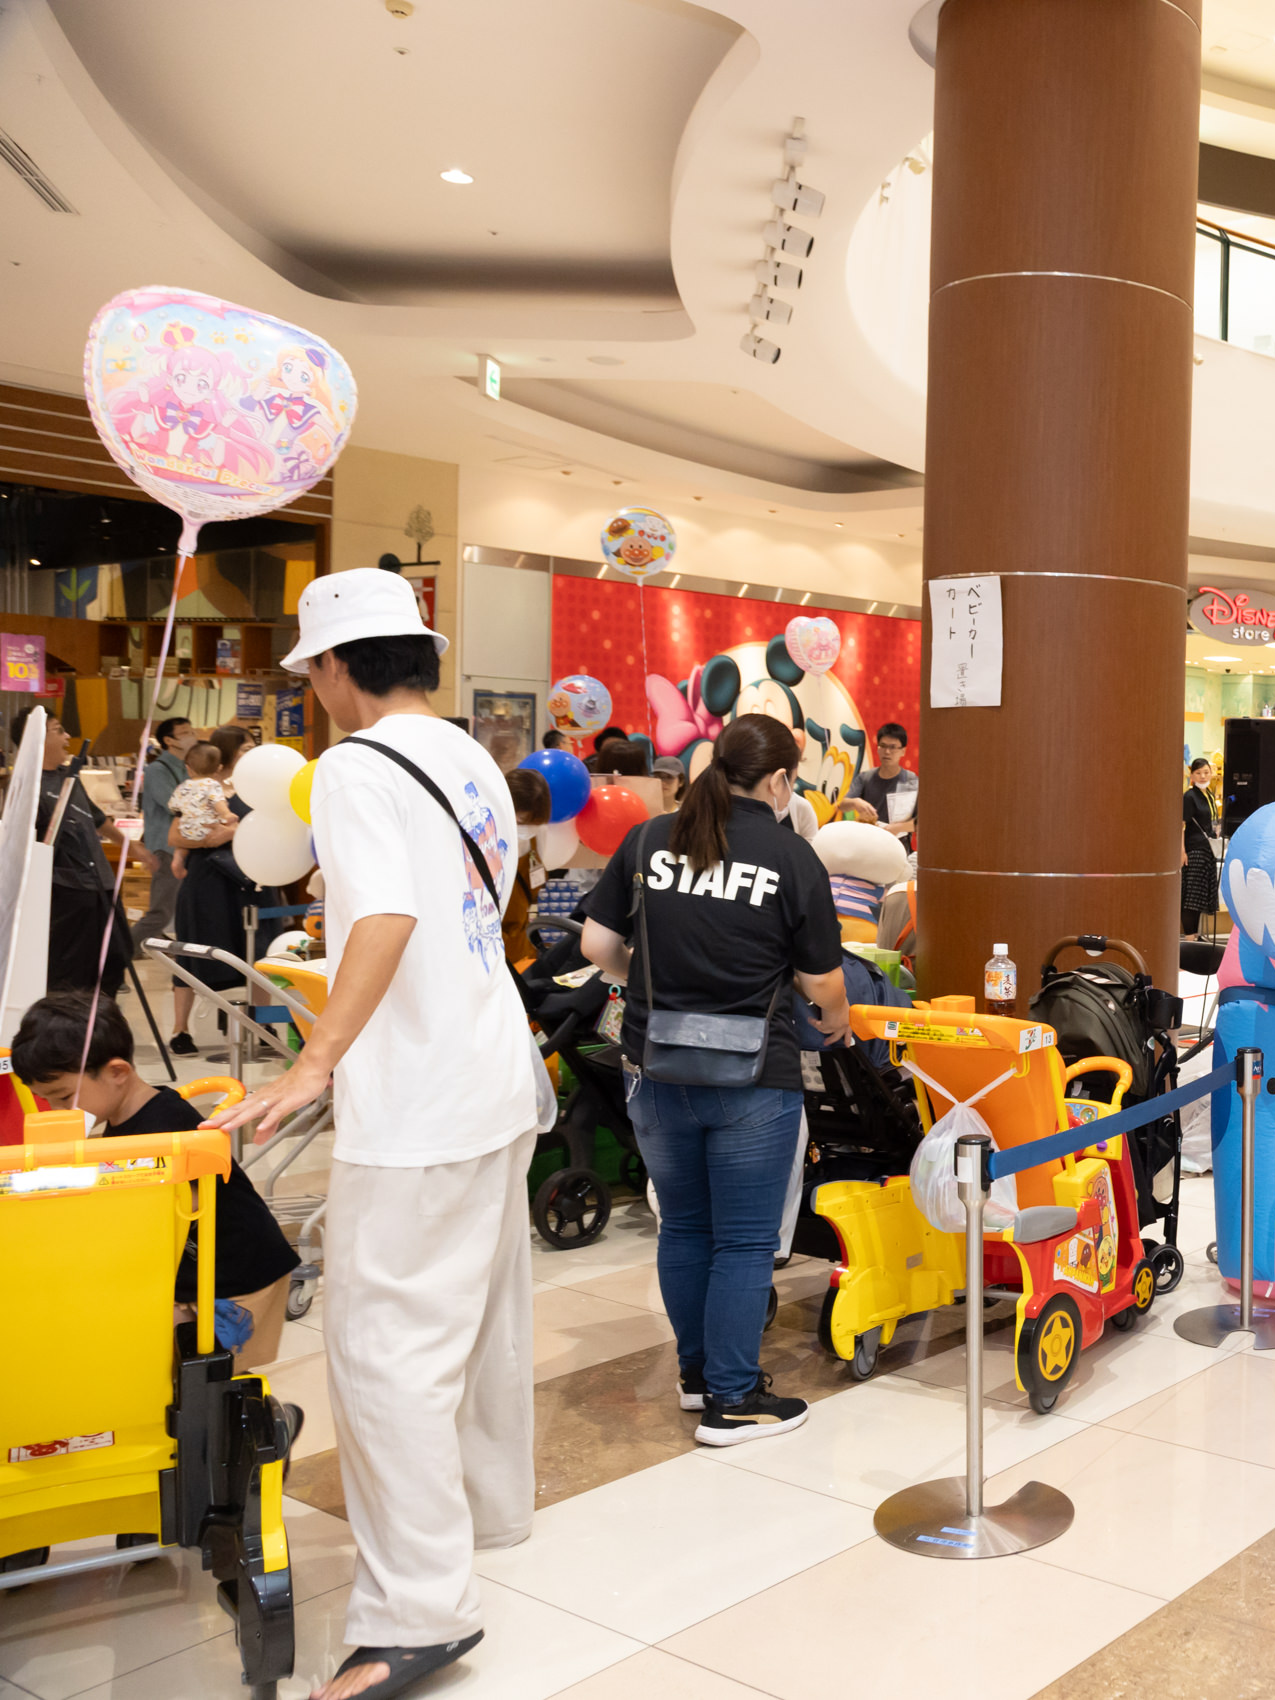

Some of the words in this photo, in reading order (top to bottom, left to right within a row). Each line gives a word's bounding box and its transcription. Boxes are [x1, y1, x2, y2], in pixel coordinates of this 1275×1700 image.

[946, 588, 957, 640] カート
[967, 583, 982, 660] ベビーカー
[1232, 626, 1270, 641] store
[647, 850, 780, 906] STAFF
[1003, 974, 1013, 998] 麦茶
